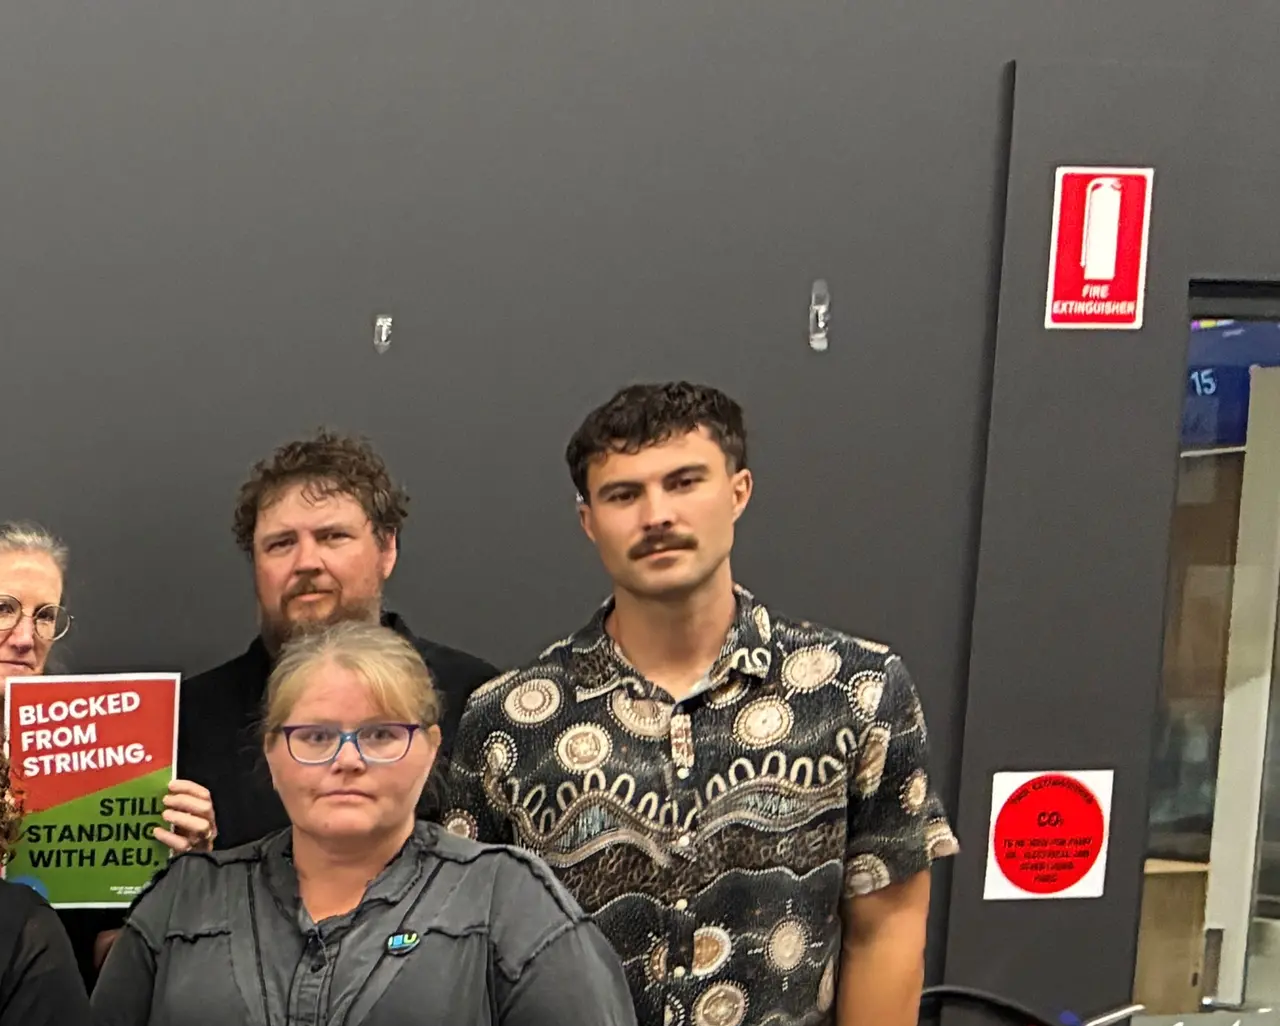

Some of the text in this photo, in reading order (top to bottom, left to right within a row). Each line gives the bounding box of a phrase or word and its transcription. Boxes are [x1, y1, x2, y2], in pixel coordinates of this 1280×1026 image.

[1082, 284, 1109, 299] FIRE
[1052, 301, 1136, 315] EXTINGUISHER
[1191, 369, 1217, 396] 15
[18, 691, 141, 726] BLOCKED
[21, 722, 97, 752] FROM
[22, 743, 153, 777] STRIKING.
[100, 797, 162, 817] STILL
[27, 822, 157, 844] STANDING
[28, 848, 159, 868] WITH AEU.
